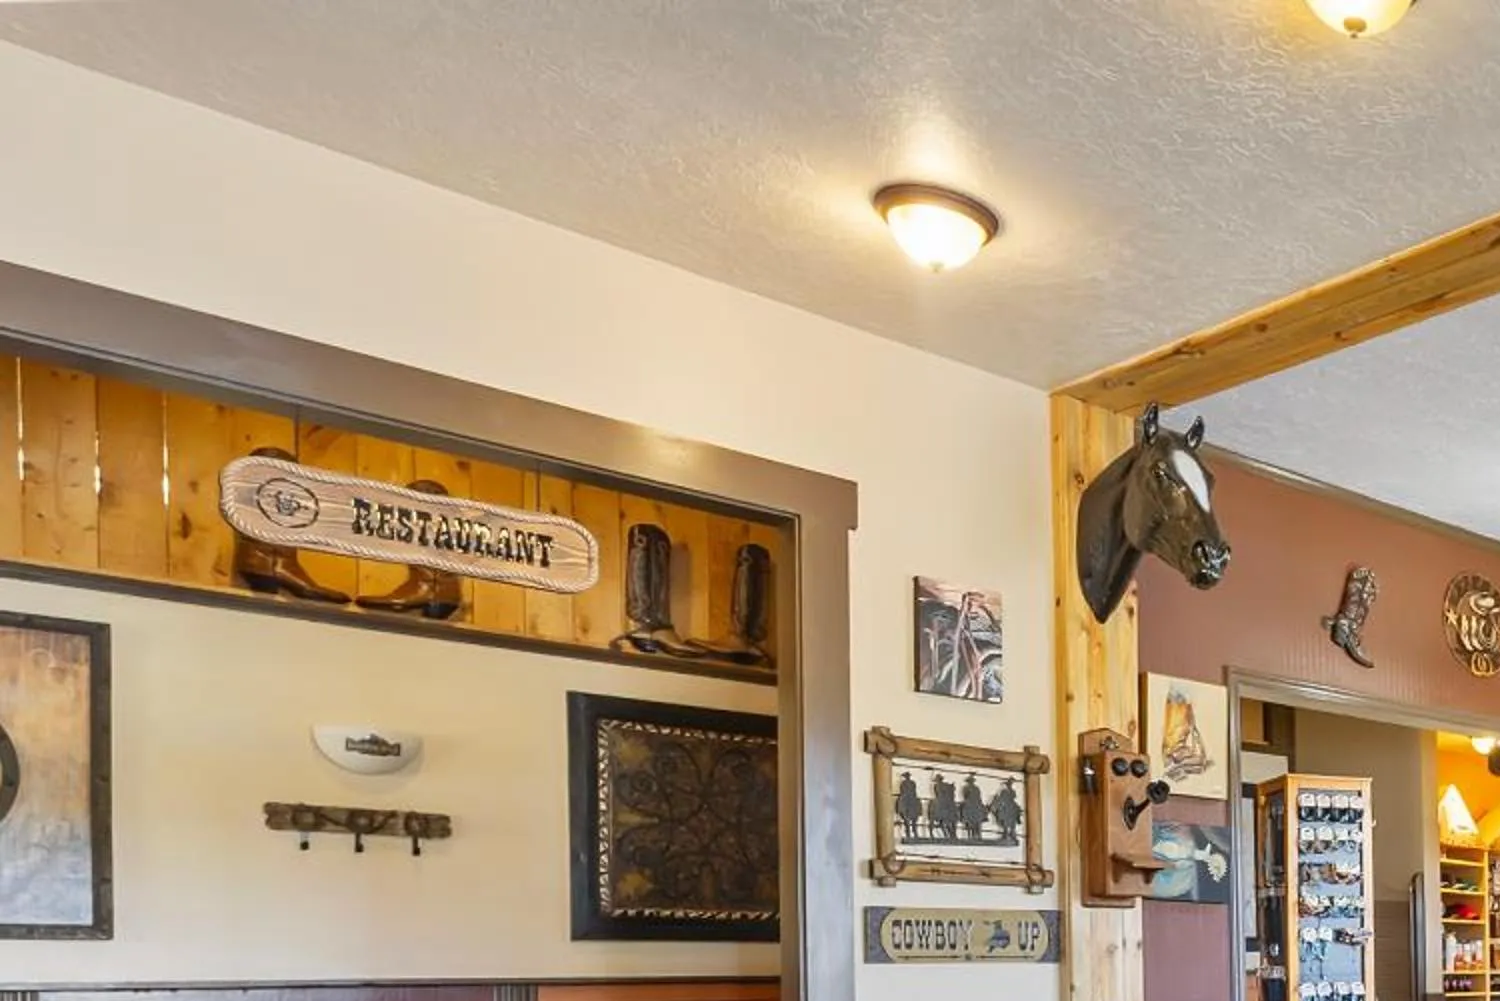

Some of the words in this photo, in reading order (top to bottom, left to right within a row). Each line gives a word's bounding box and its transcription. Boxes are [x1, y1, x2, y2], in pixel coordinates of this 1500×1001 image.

[351, 497, 553, 567] RESTAURANT
[892, 919, 972, 951] COWBOY
[1018, 921, 1041, 951] UP
